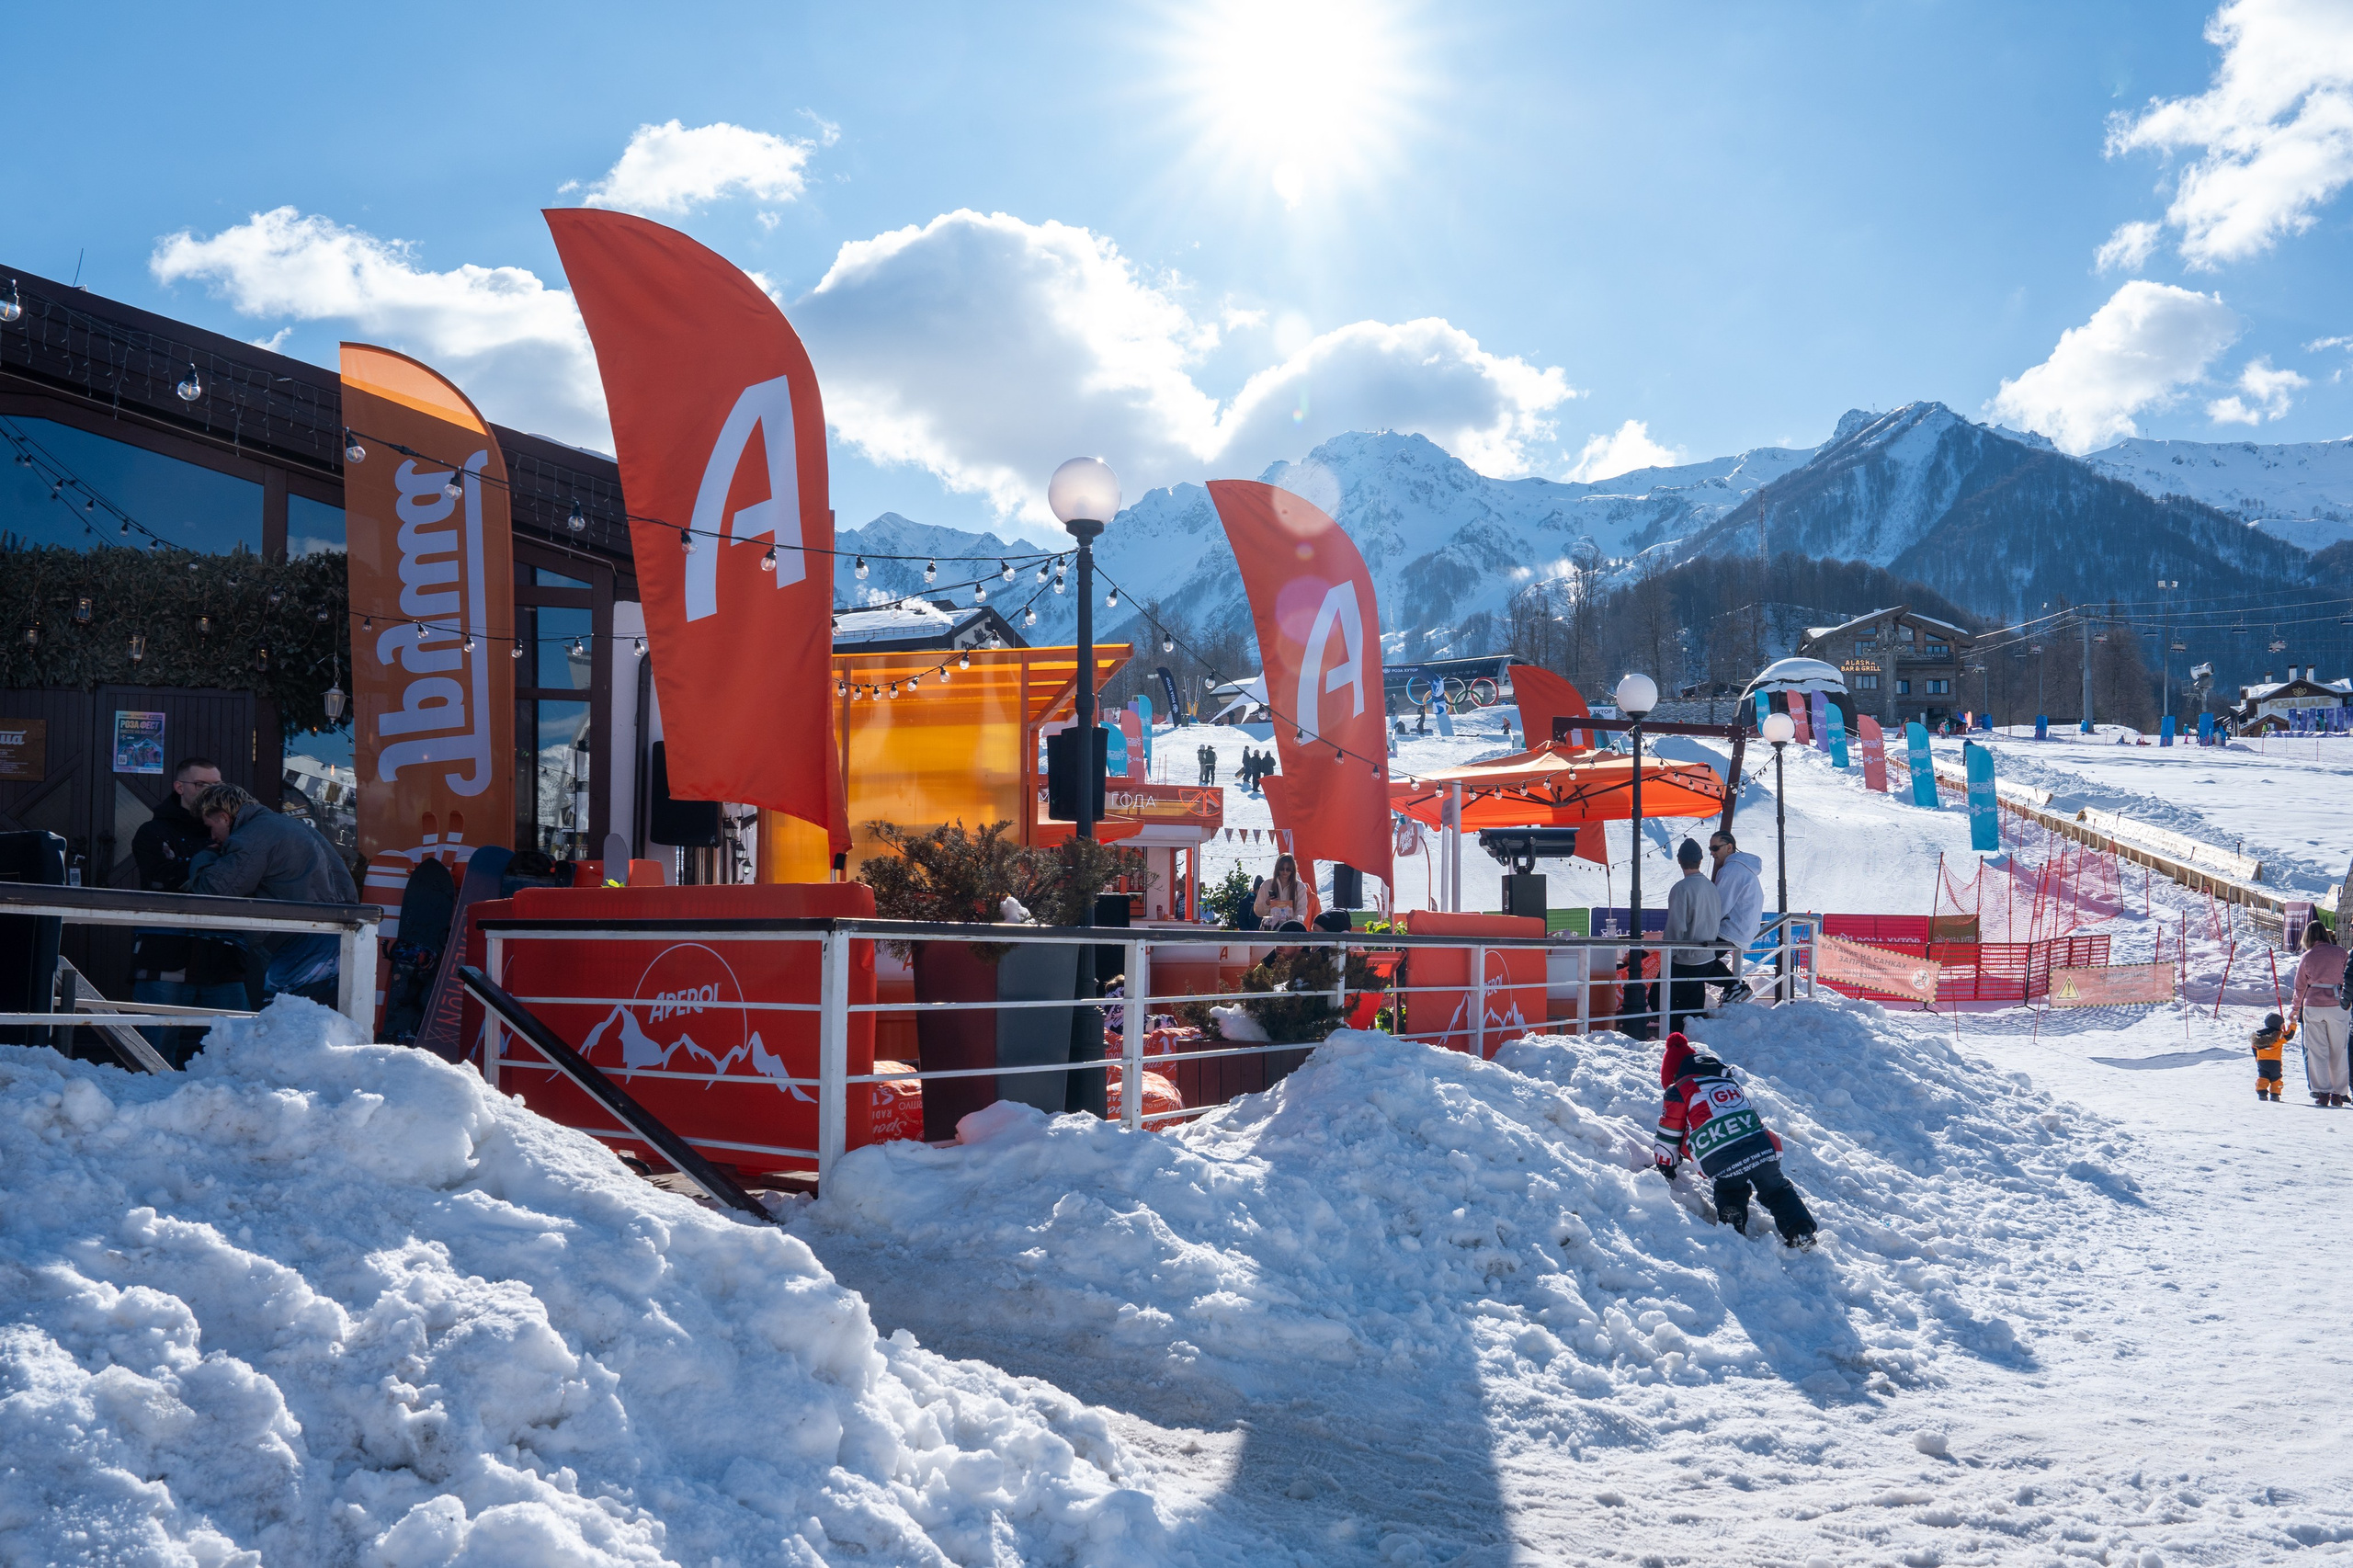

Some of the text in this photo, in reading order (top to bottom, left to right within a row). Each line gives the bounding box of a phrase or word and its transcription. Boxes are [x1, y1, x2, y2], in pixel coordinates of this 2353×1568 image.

[685, 374, 806, 622] A
[2268, 697, 2332, 710] РОЗА ШАЛЕ
[120, 721, 160, 730] РОЗА ФЕСТ
[1111, 793, 1156, 809] ГОДА
[1822, 943, 1859, 957] КАТАНИЕ
[1873, 957, 1907, 969] САНКАХ
[1714, 1088, 1741, 1103] GH
[1688, 1114, 1752, 1155] OCKEY
[1732, 1161, 1743, 1169] ONE
